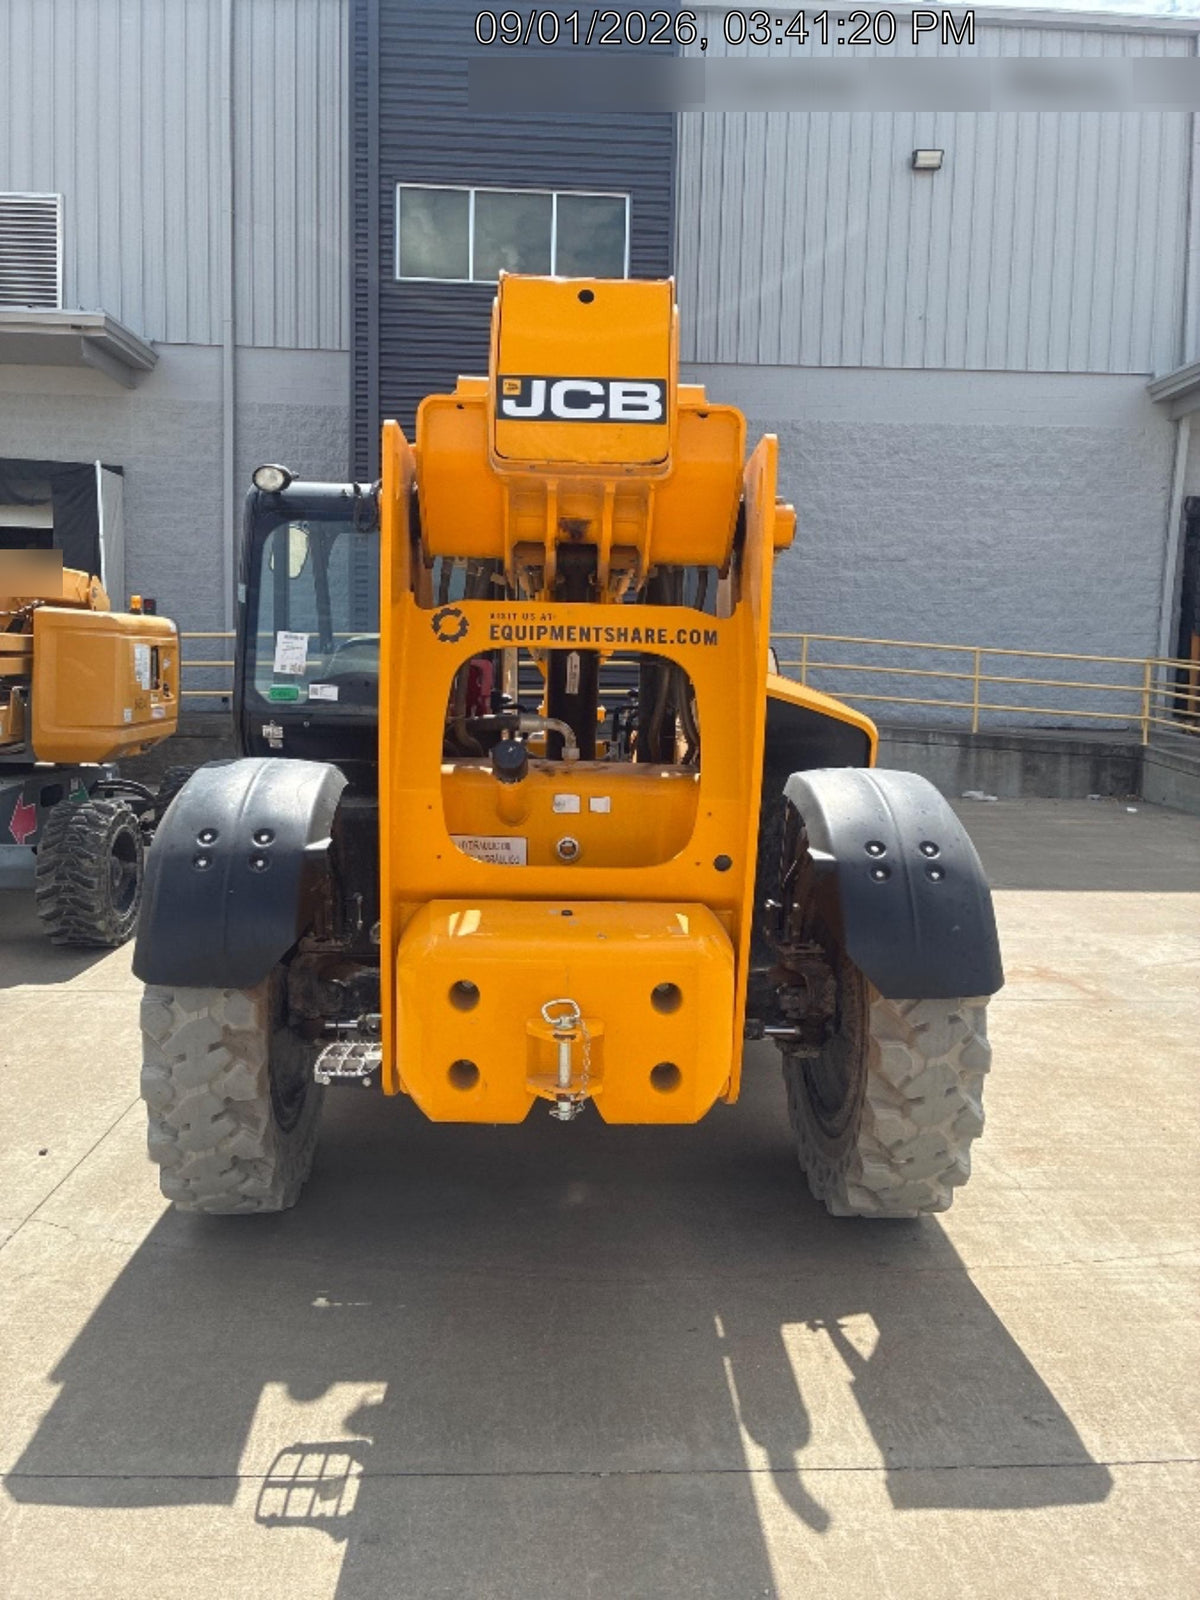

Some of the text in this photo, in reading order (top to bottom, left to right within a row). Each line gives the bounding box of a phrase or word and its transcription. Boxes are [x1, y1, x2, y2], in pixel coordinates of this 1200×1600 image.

[502, 379, 663, 420] JCB
[522, 613, 536, 621] US
[489, 623, 719, 646] EQUIPMENTSHARE.COM
